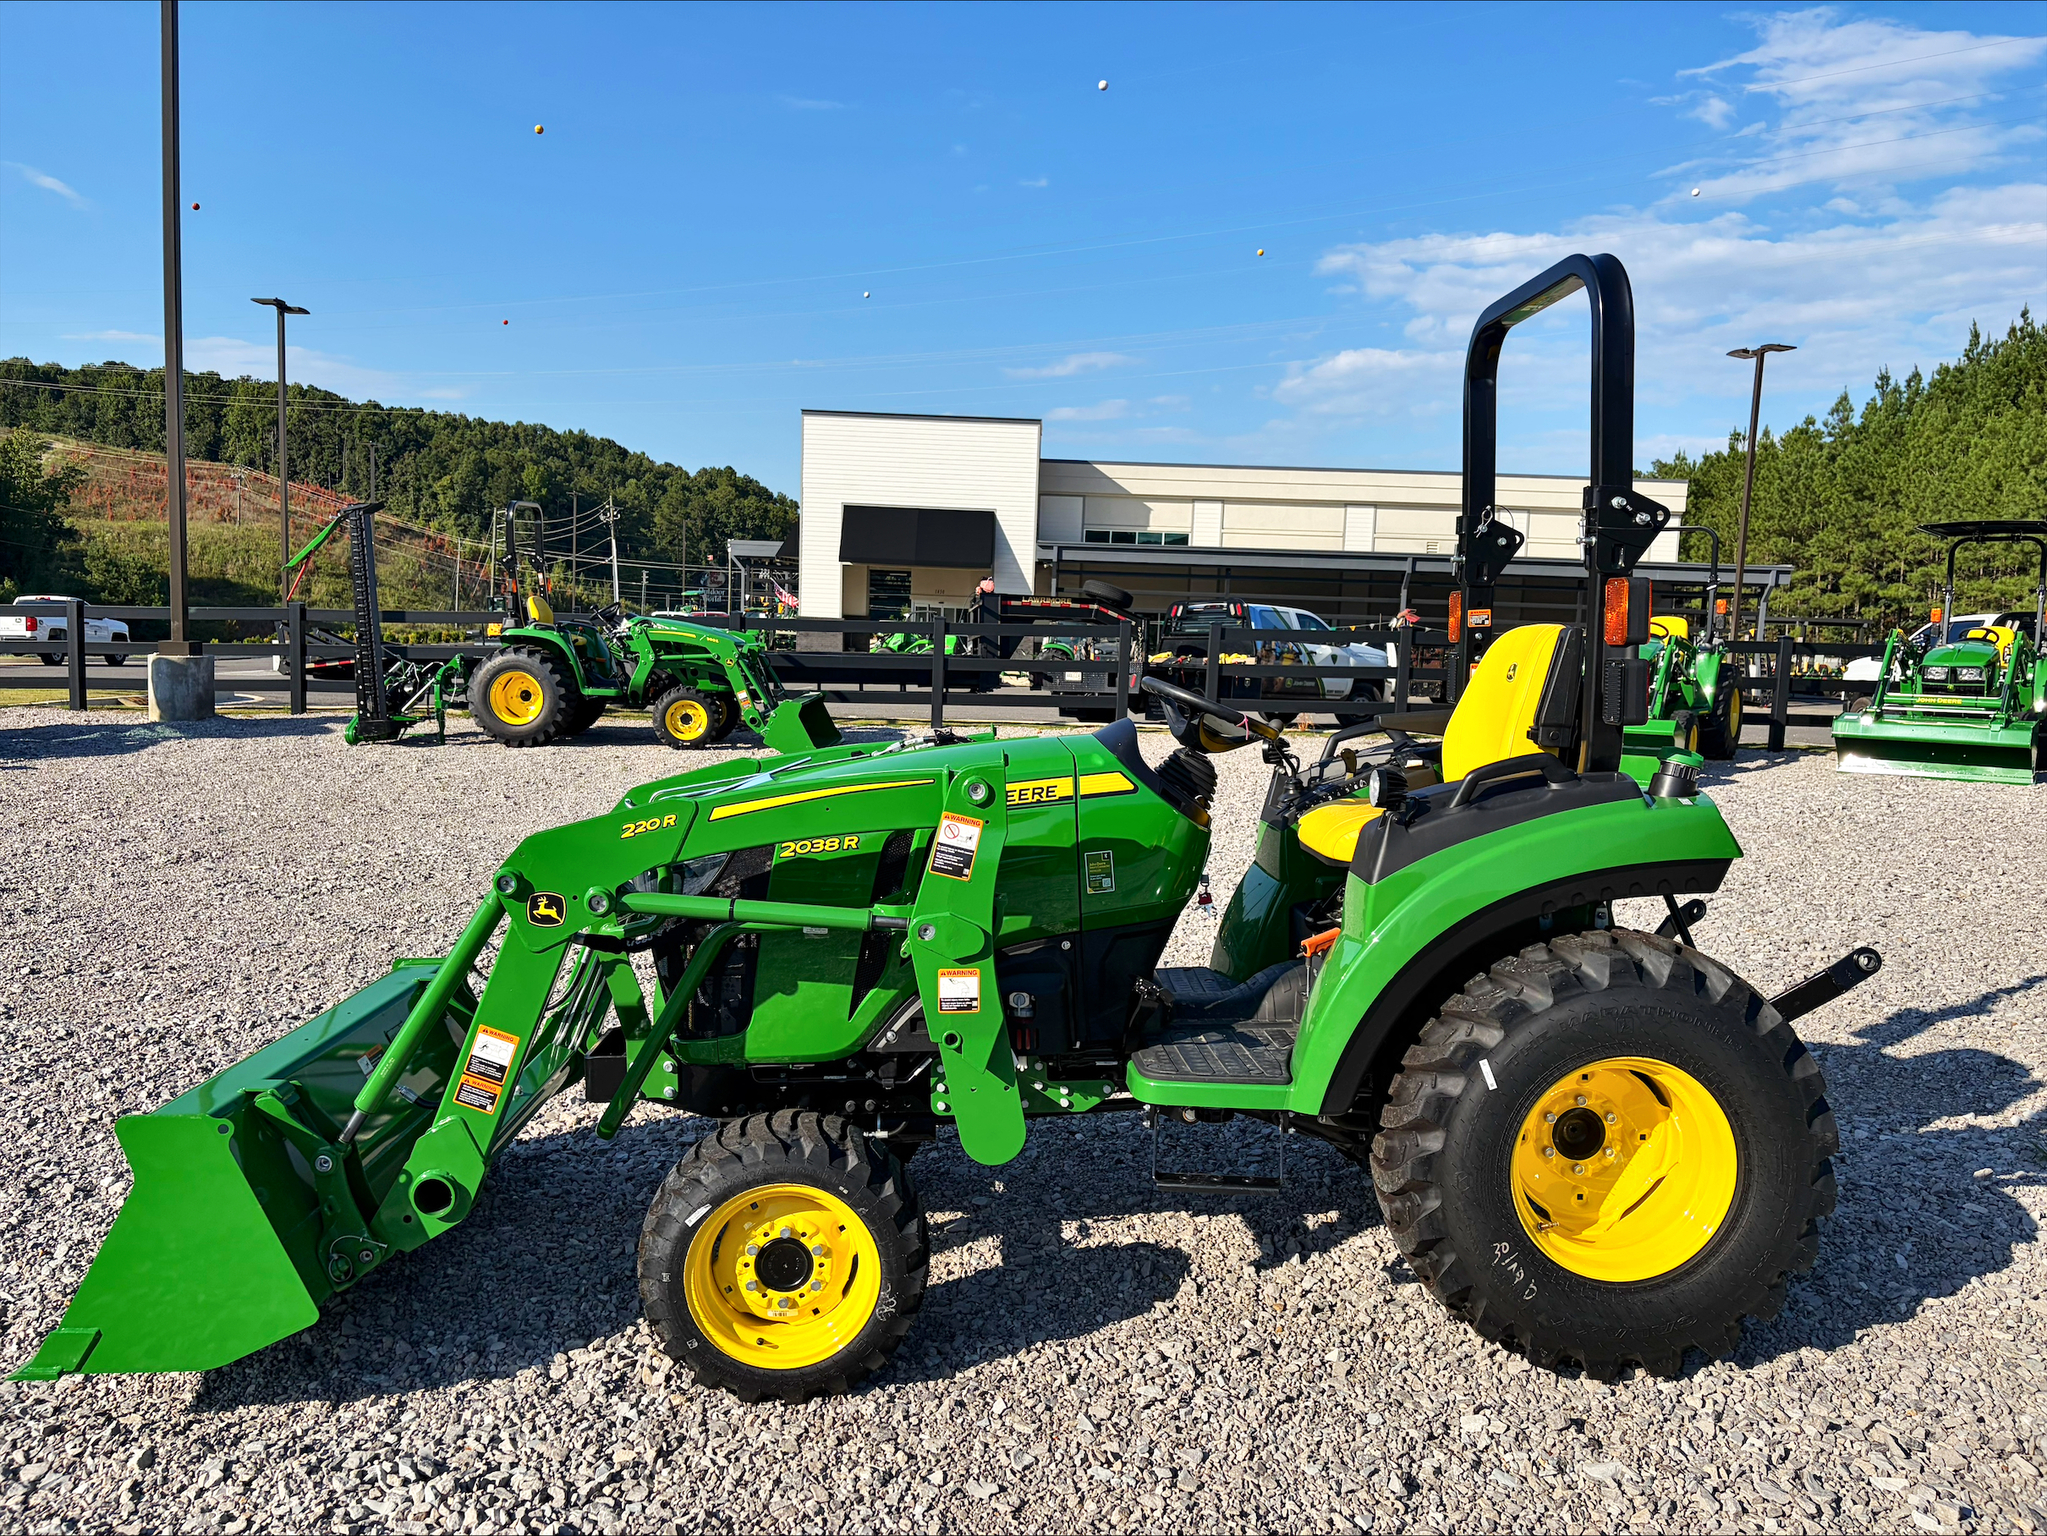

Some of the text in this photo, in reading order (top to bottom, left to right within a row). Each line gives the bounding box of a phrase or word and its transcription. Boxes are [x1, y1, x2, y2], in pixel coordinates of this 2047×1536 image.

[1022, 596, 1072, 605] LAWRIMORE
[1007, 785, 1058, 803] EERE
[620, 814, 677, 839] 220 R
[951, 814, 981, 827] WARNING
[779, 836, 859, 859] 2038 R
[489, 1030, 514, 1043] WARNING
